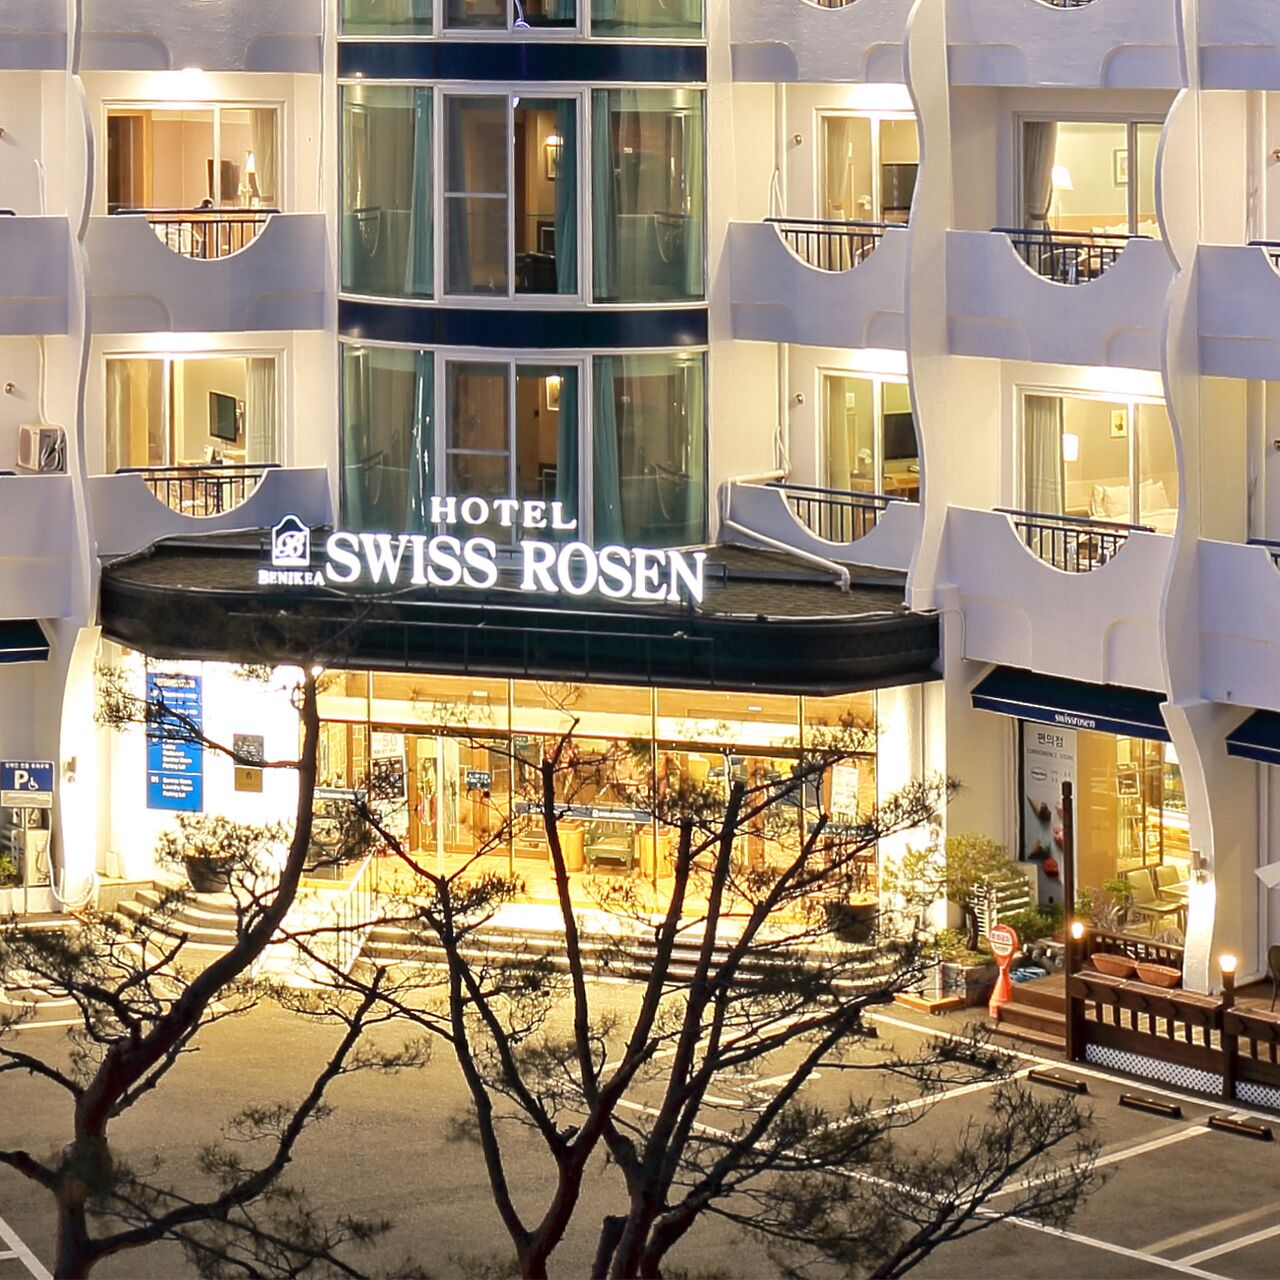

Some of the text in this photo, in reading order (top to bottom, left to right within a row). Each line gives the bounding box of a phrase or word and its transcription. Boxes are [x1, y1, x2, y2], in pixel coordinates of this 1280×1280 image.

[430, 495, 577, 530] HOTEL
[257, 568, 325, 586] BENIKEA
[325, 531, 708, 604] SWISS ROSEN
[1036, 732, 1064, 748] 편의점
[14, 770, 29, 789] P
